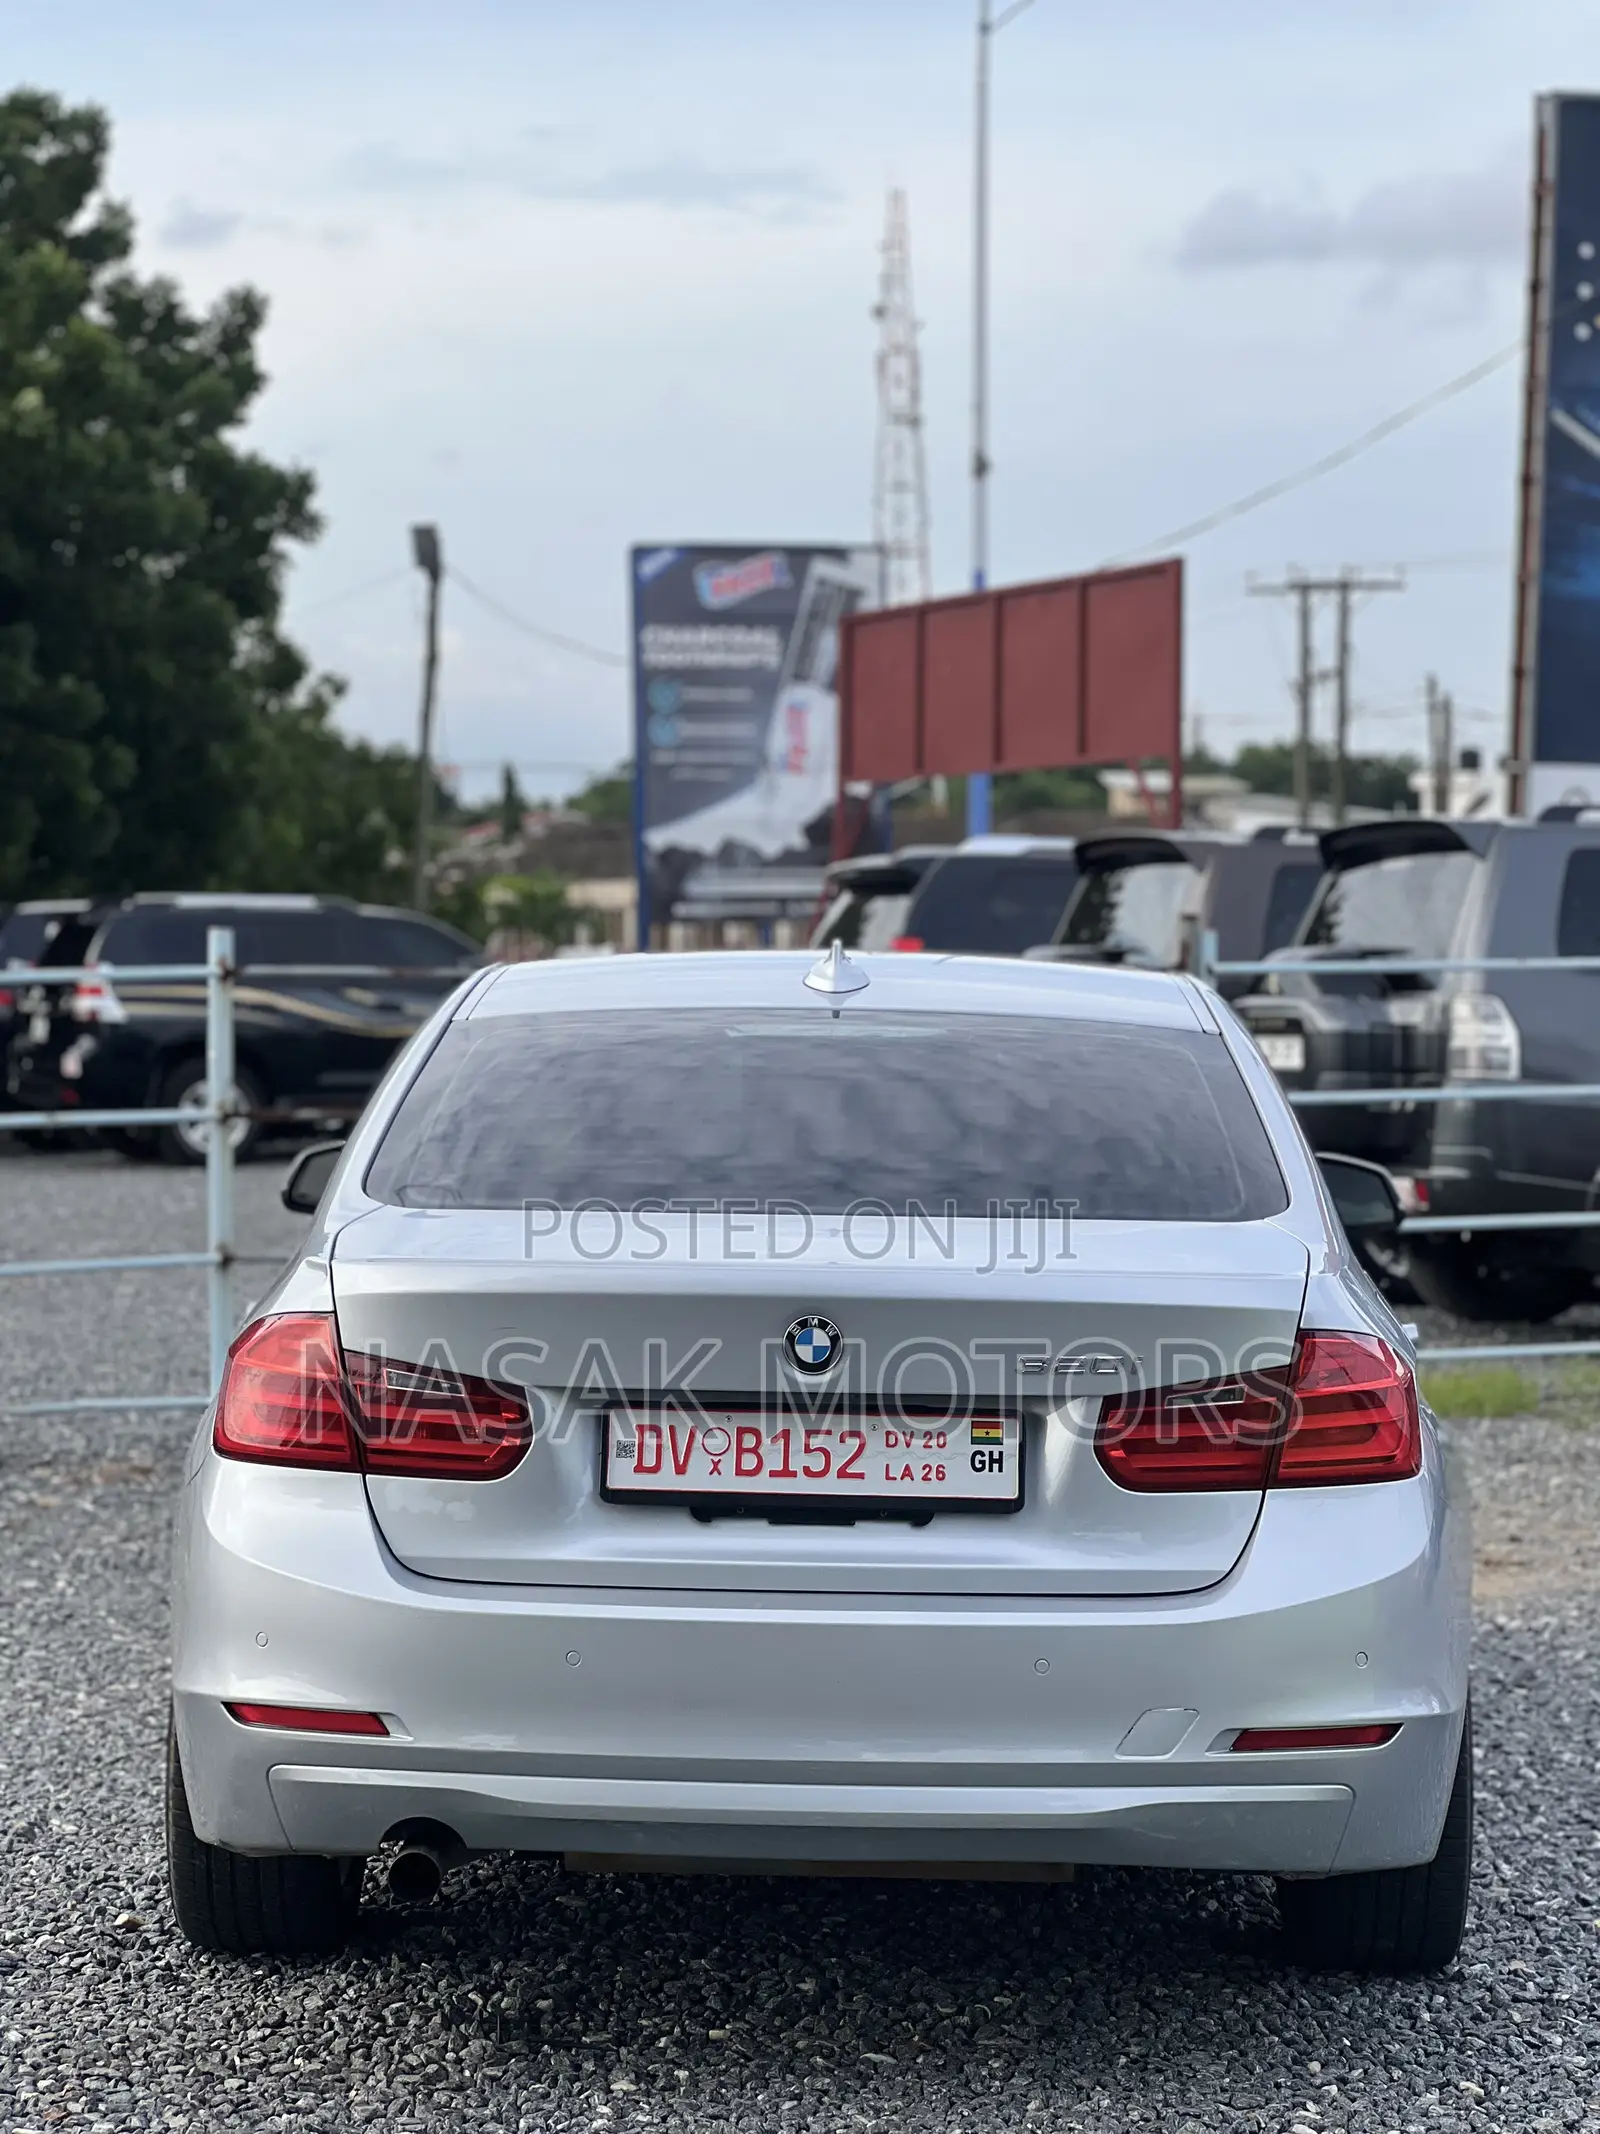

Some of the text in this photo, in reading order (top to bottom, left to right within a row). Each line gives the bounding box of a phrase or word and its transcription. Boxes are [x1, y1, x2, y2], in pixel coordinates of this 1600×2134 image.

[789, 1317, 838, 1337] BMW
[884, 1430, 948, 1449] DV 20
[970, 1449, 1004, 1474] GH
[884, 1463, 947, 1481] LA 26
